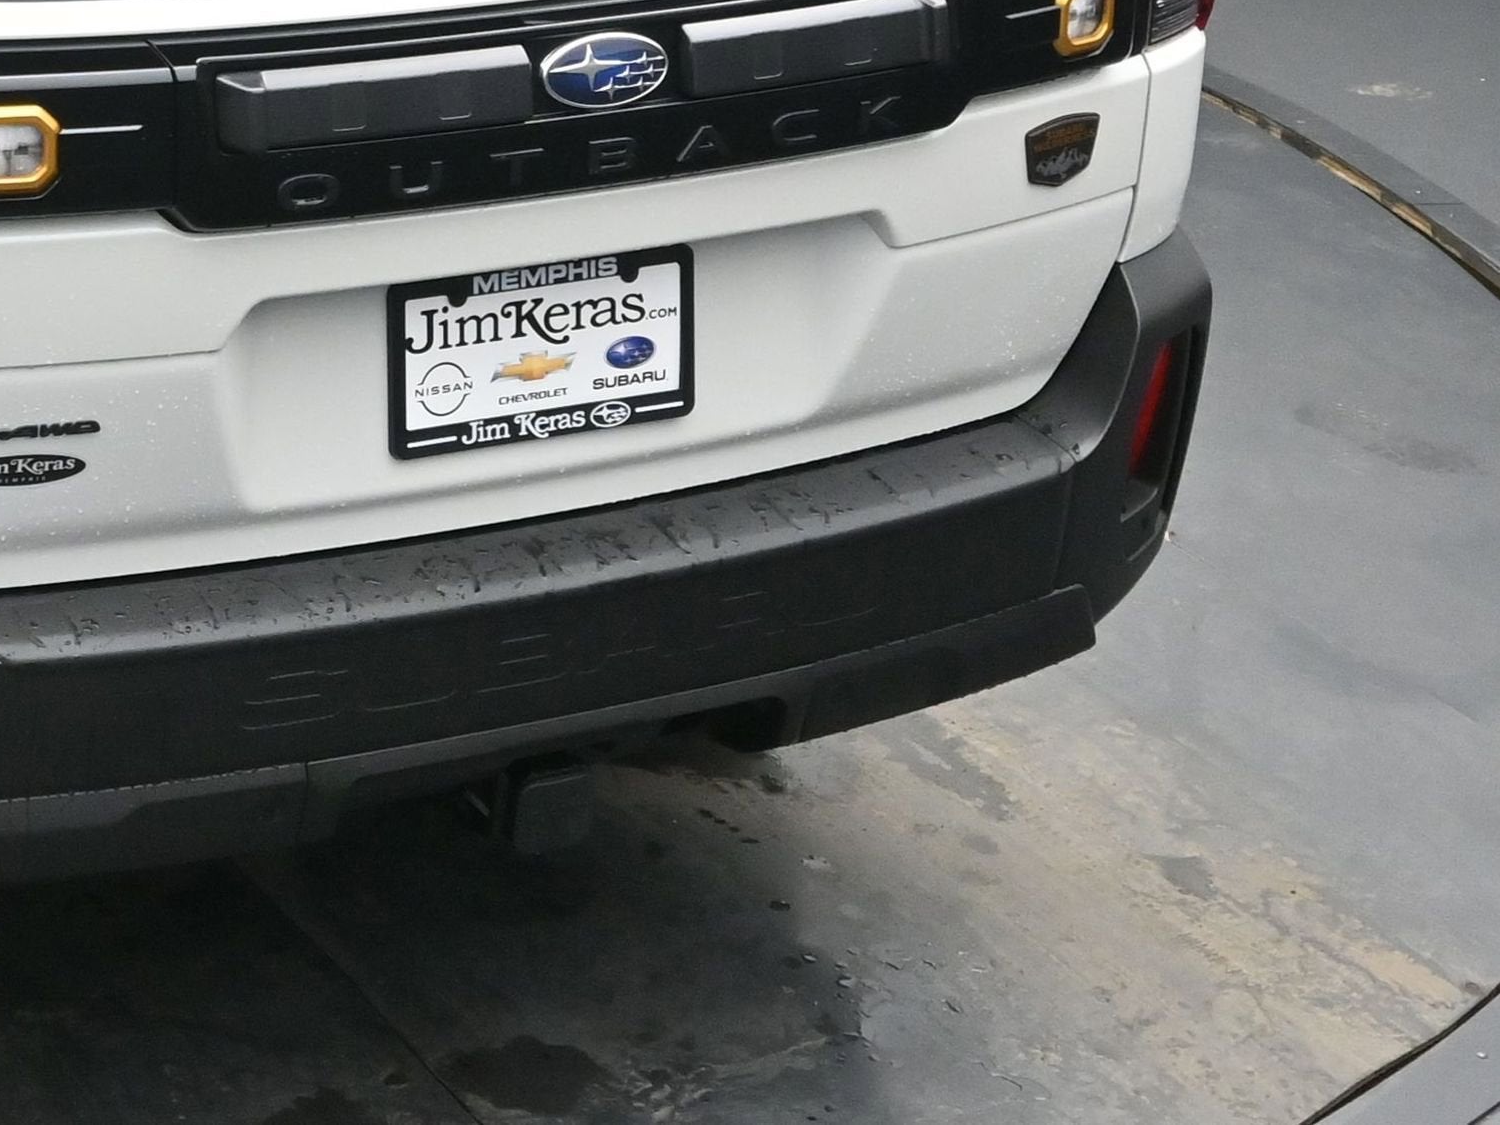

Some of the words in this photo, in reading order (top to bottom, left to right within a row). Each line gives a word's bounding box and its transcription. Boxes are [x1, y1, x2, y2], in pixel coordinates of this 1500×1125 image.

[275, 95, 902, 212] OUTBACK
[472, 256, 619, 295] MEMPHIS
[414, 380, 474, 398] NISSAN
[592, 368, 668, 391] SUBARU
[498, 387, 569, 406] CHEVROLET
[461, 418, 510, 446] Jim
[513, 407, 587, 439] Keras
